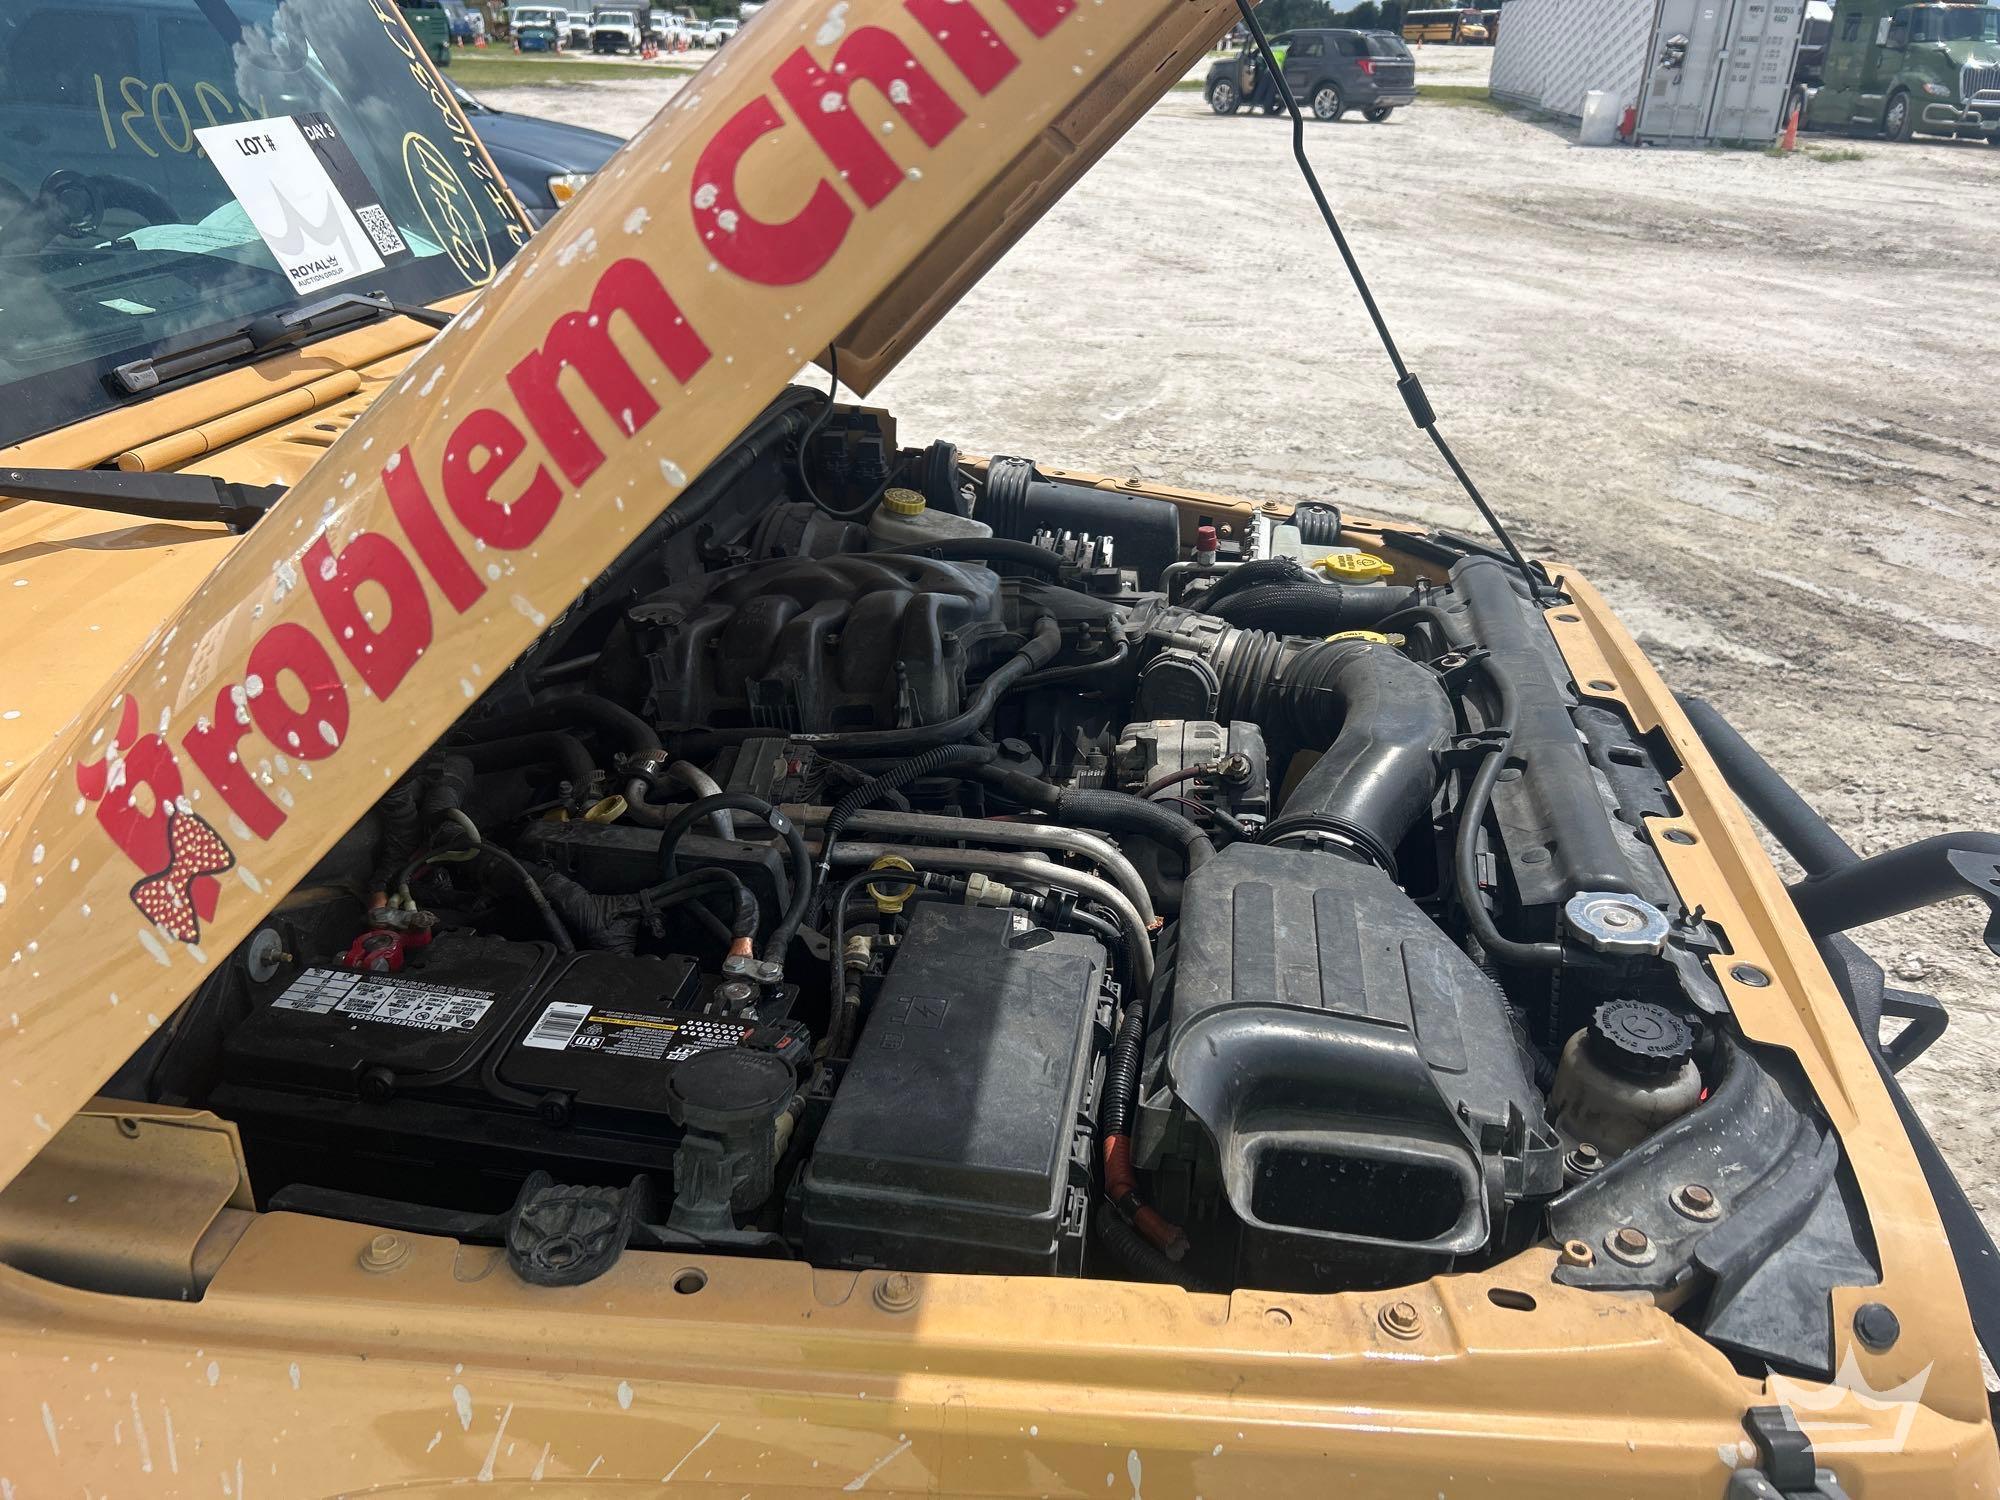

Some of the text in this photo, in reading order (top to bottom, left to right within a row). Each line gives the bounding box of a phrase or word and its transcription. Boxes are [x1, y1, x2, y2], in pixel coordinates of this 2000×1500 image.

[303, 123, 335, 141] DAY 3
[235, 134, 277, 156] LOT #
[289, 259, 329, 280] ROYAL
[298, 267, 344, 287] AUCTION GROUP
[349, 1012, 440, 1031] DANGER/POISON
[575, 1036, 600, 1047] STD
